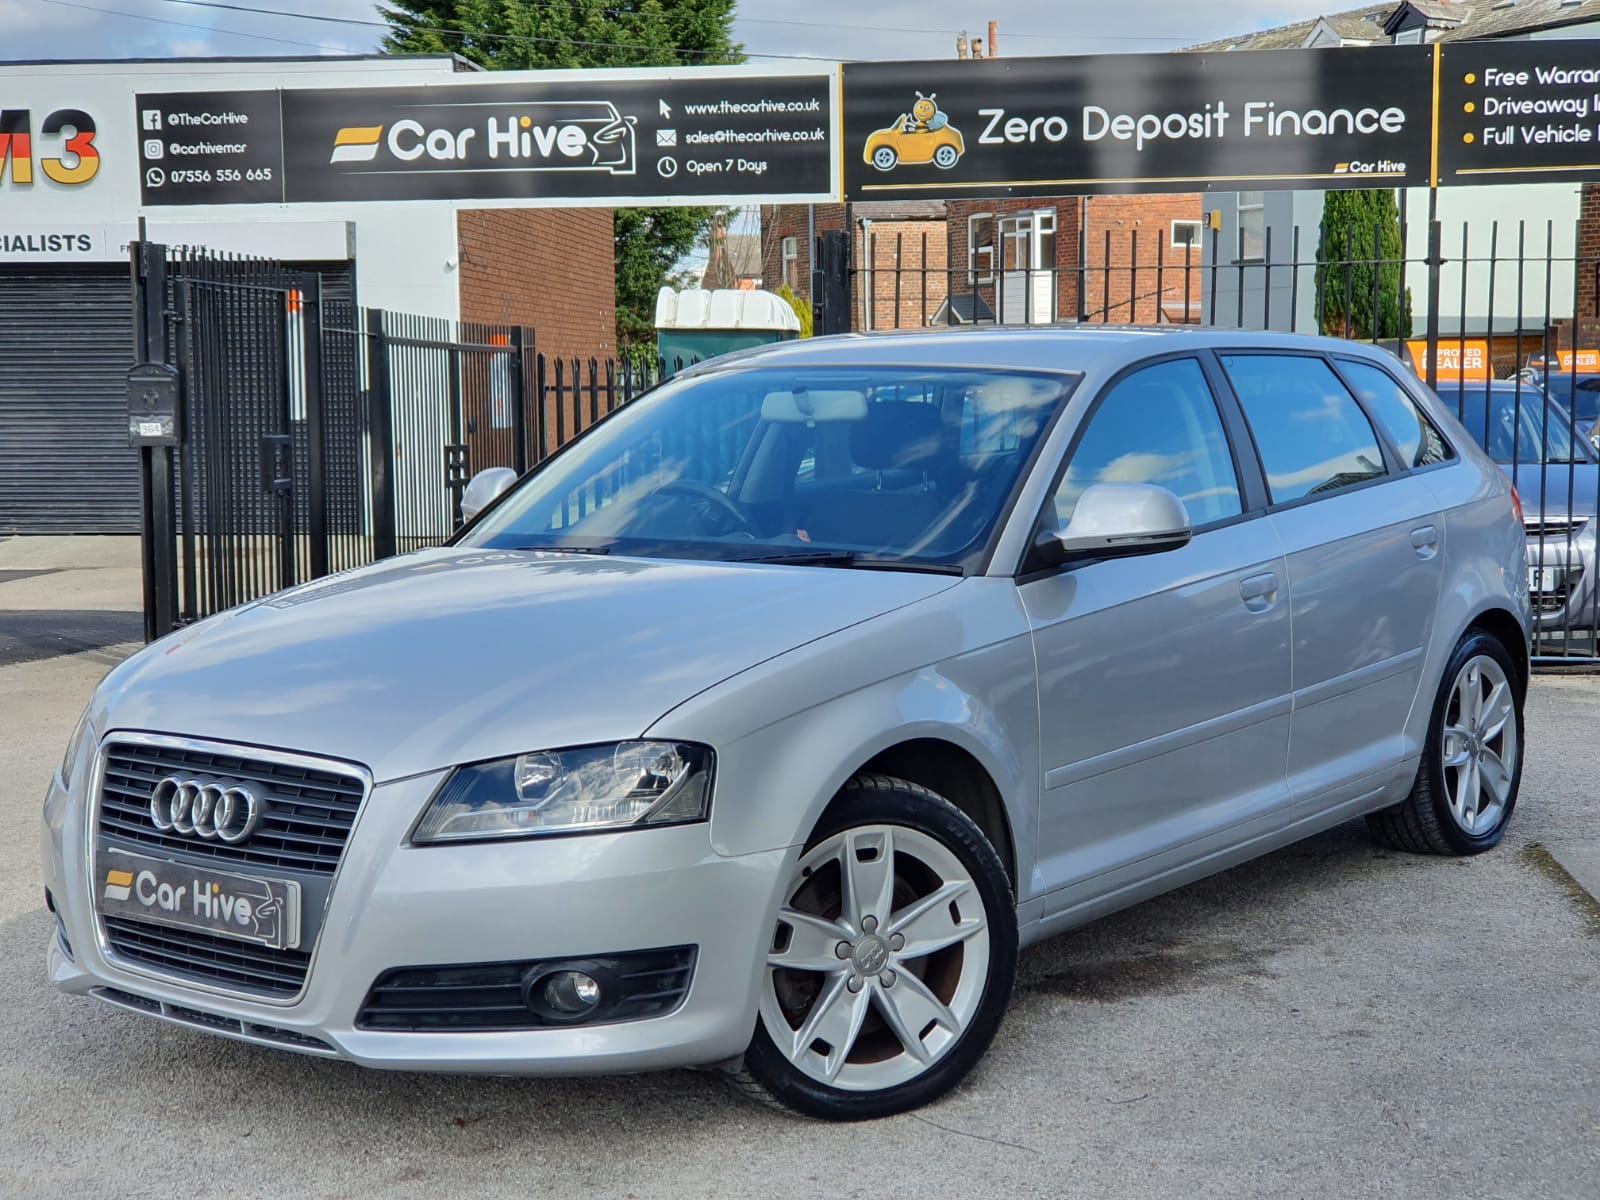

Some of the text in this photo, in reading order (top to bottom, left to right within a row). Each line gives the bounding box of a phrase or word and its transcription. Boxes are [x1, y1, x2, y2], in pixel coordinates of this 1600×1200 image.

[1484, 67, 1529, 87] Free
[684, 98, 820, 115] www.thecarhive.co.uk
[1483, 97, 1588, 118] Driveaway
[167, 111, 249, 126] @TheCarHive
[978, 100, 1406, 151] Zero Deposit Finance
[387, 115, 588, 161] Car Hive
[685, 127, 825, 144] sales@thecarhive.co.uk
[1483, 125, 1515, 146] Full
[1520, 123, 1592, 144] Vehicle
[169, 141, 248, 156] @carhivemcr
[170, 167, 272, 183] 07556 556 665
[686, 158, 768, 176] Open 7 Days
[1349, 159, 1406, 173] Car Hive
[0, 234, 92, 252] IALISTS
[135, 870, 252, 926] Car Hive
